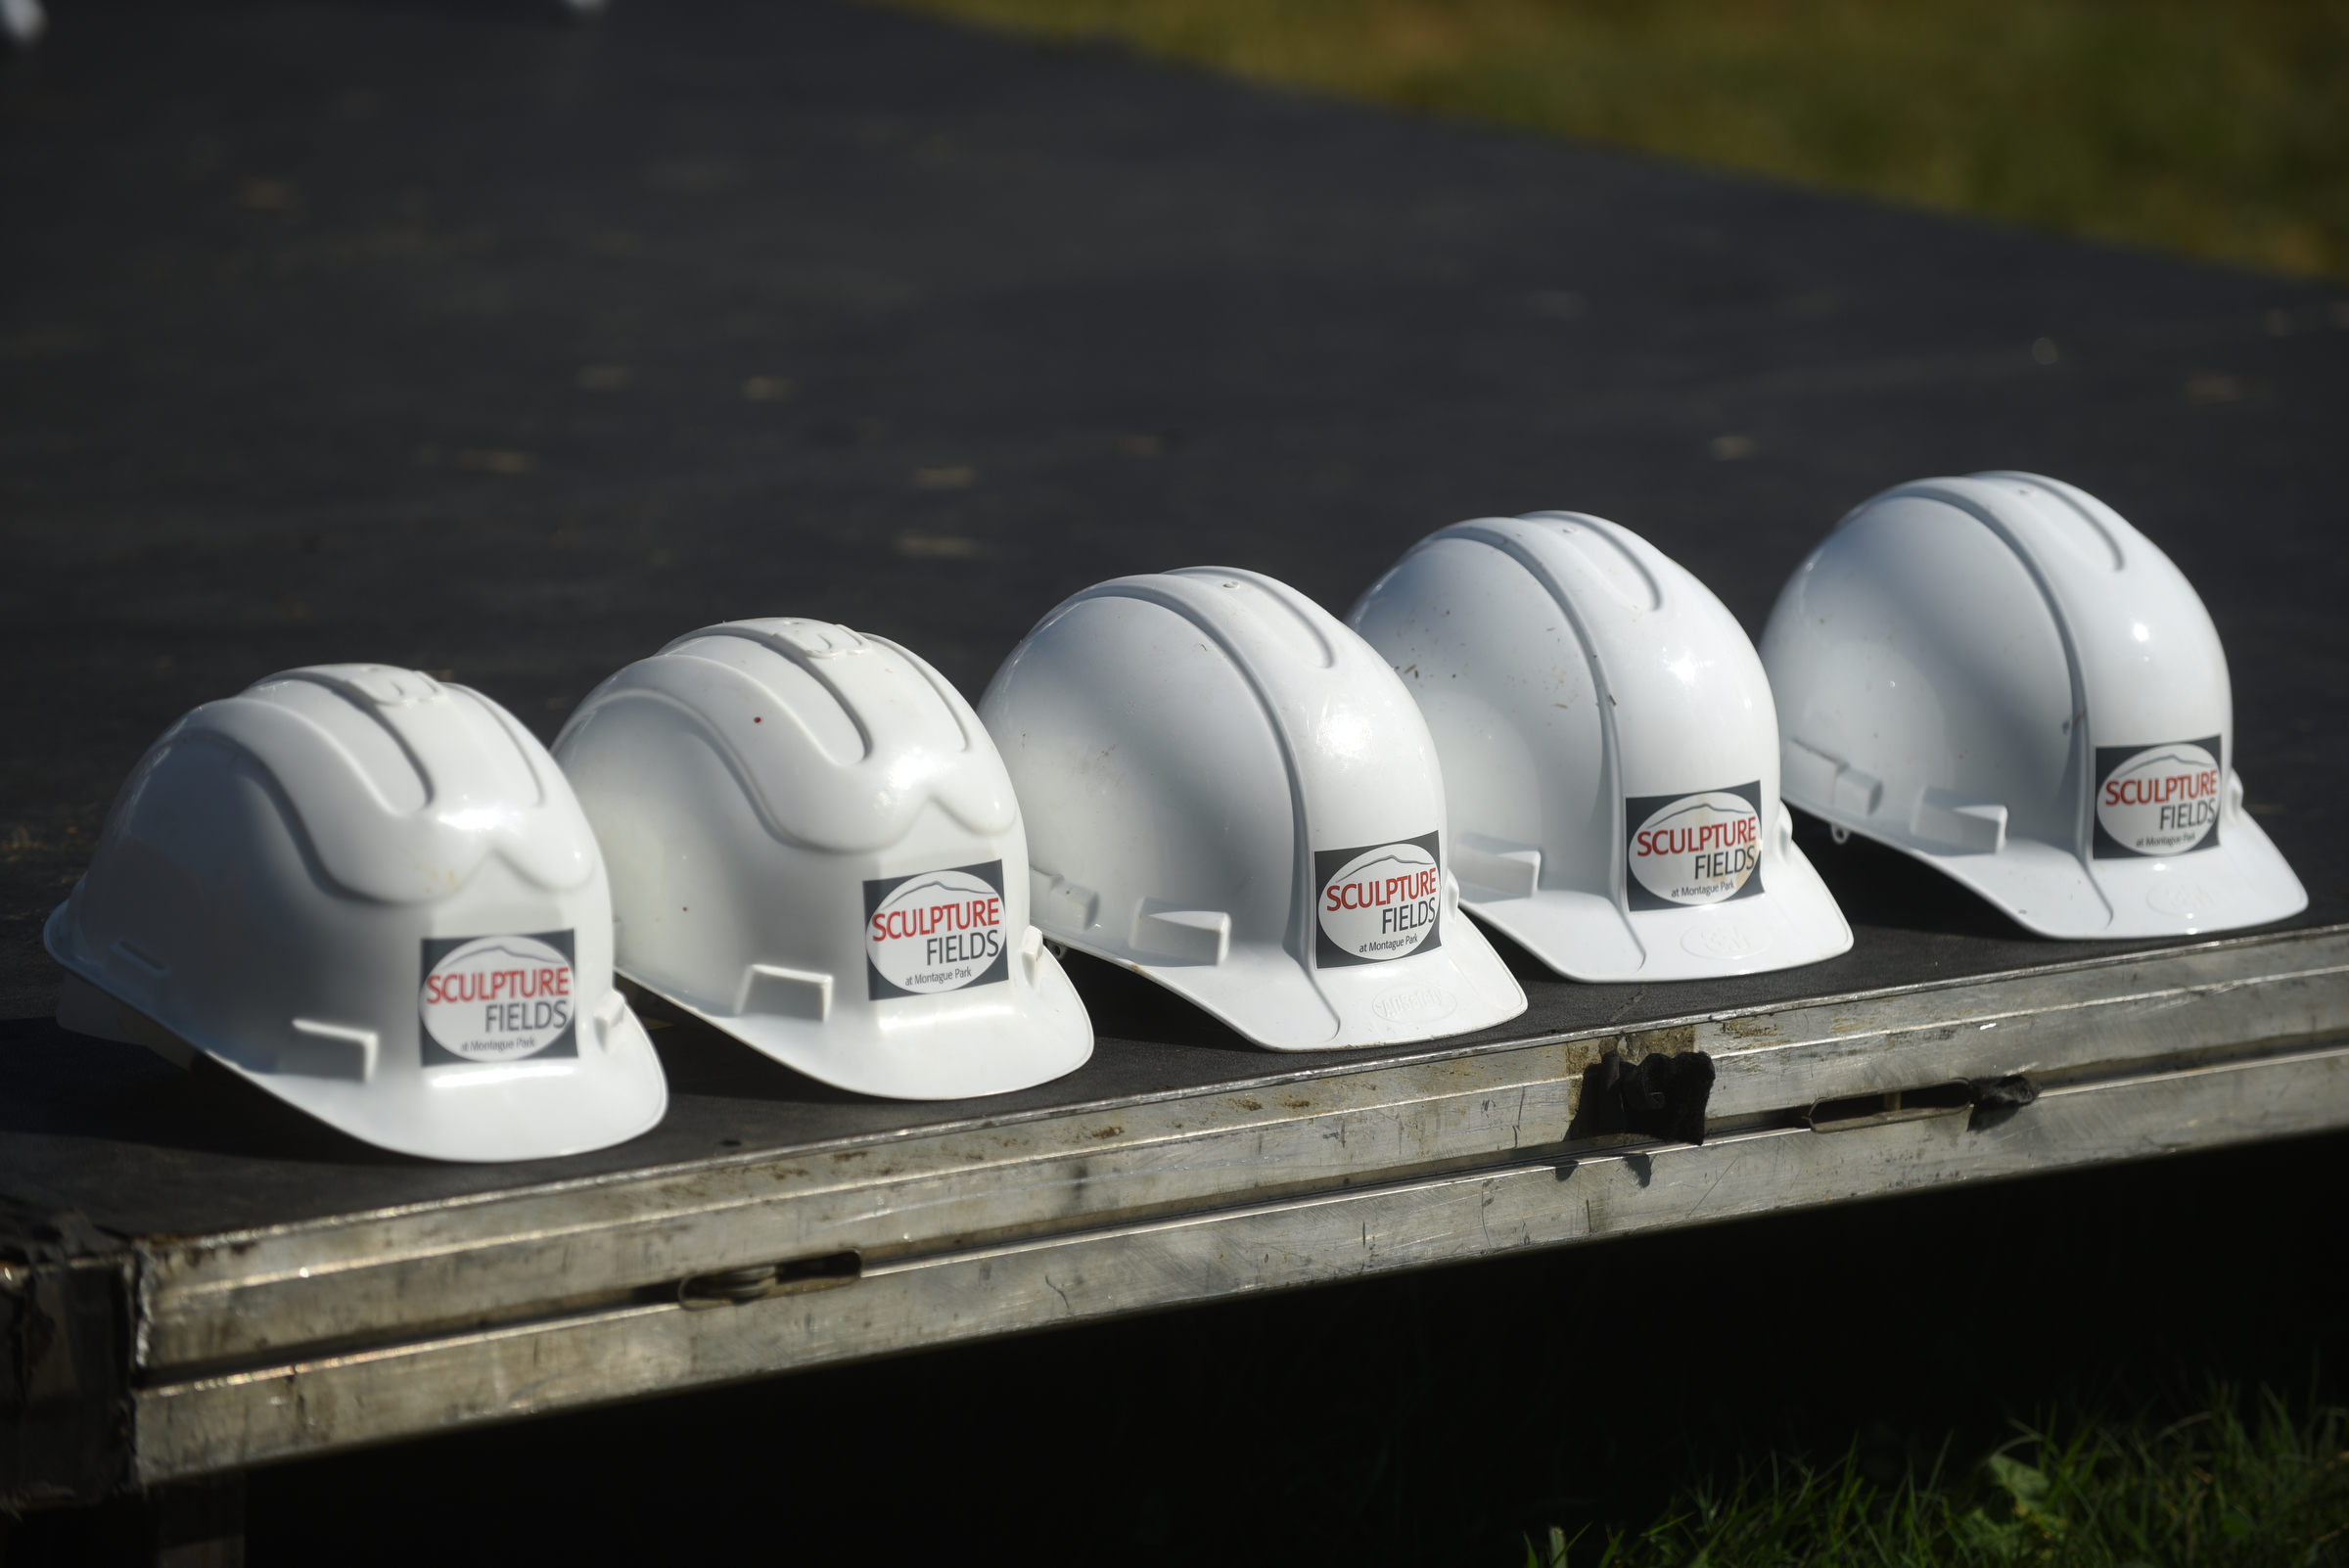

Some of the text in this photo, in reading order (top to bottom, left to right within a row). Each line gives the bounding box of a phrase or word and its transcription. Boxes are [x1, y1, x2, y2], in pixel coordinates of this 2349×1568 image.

[2105, 770, 2217, 807] SCULPTURE
[2160, 798, 2215, 830] FIELDS
[1637, 816, 1756, 856] SCULPTURE
[2137, 838, 2144, 847] at
[2146, 835, 2182, 847] Montague
[1695, 846, 1754, 880] FIELDS
[1327, 867, 1436, 911] SCULPTURE
[1672, 880, 1734, 898] at Montague Park
[872, 898, 999, 942] SCULPTURE
[1382, 898, 1435, 934] FIELDS
[927, 930, 998, 966] FIELDS
[1359, 934, 1418, 952] at Montague Park
[427, 967, 569, 1004] SCULPTURE
[905, 966, 971, 986] at Montague Park
[485, 999, 567, 1033] FIELDS
[460, 1037, 535, 1052] at Montague Park
